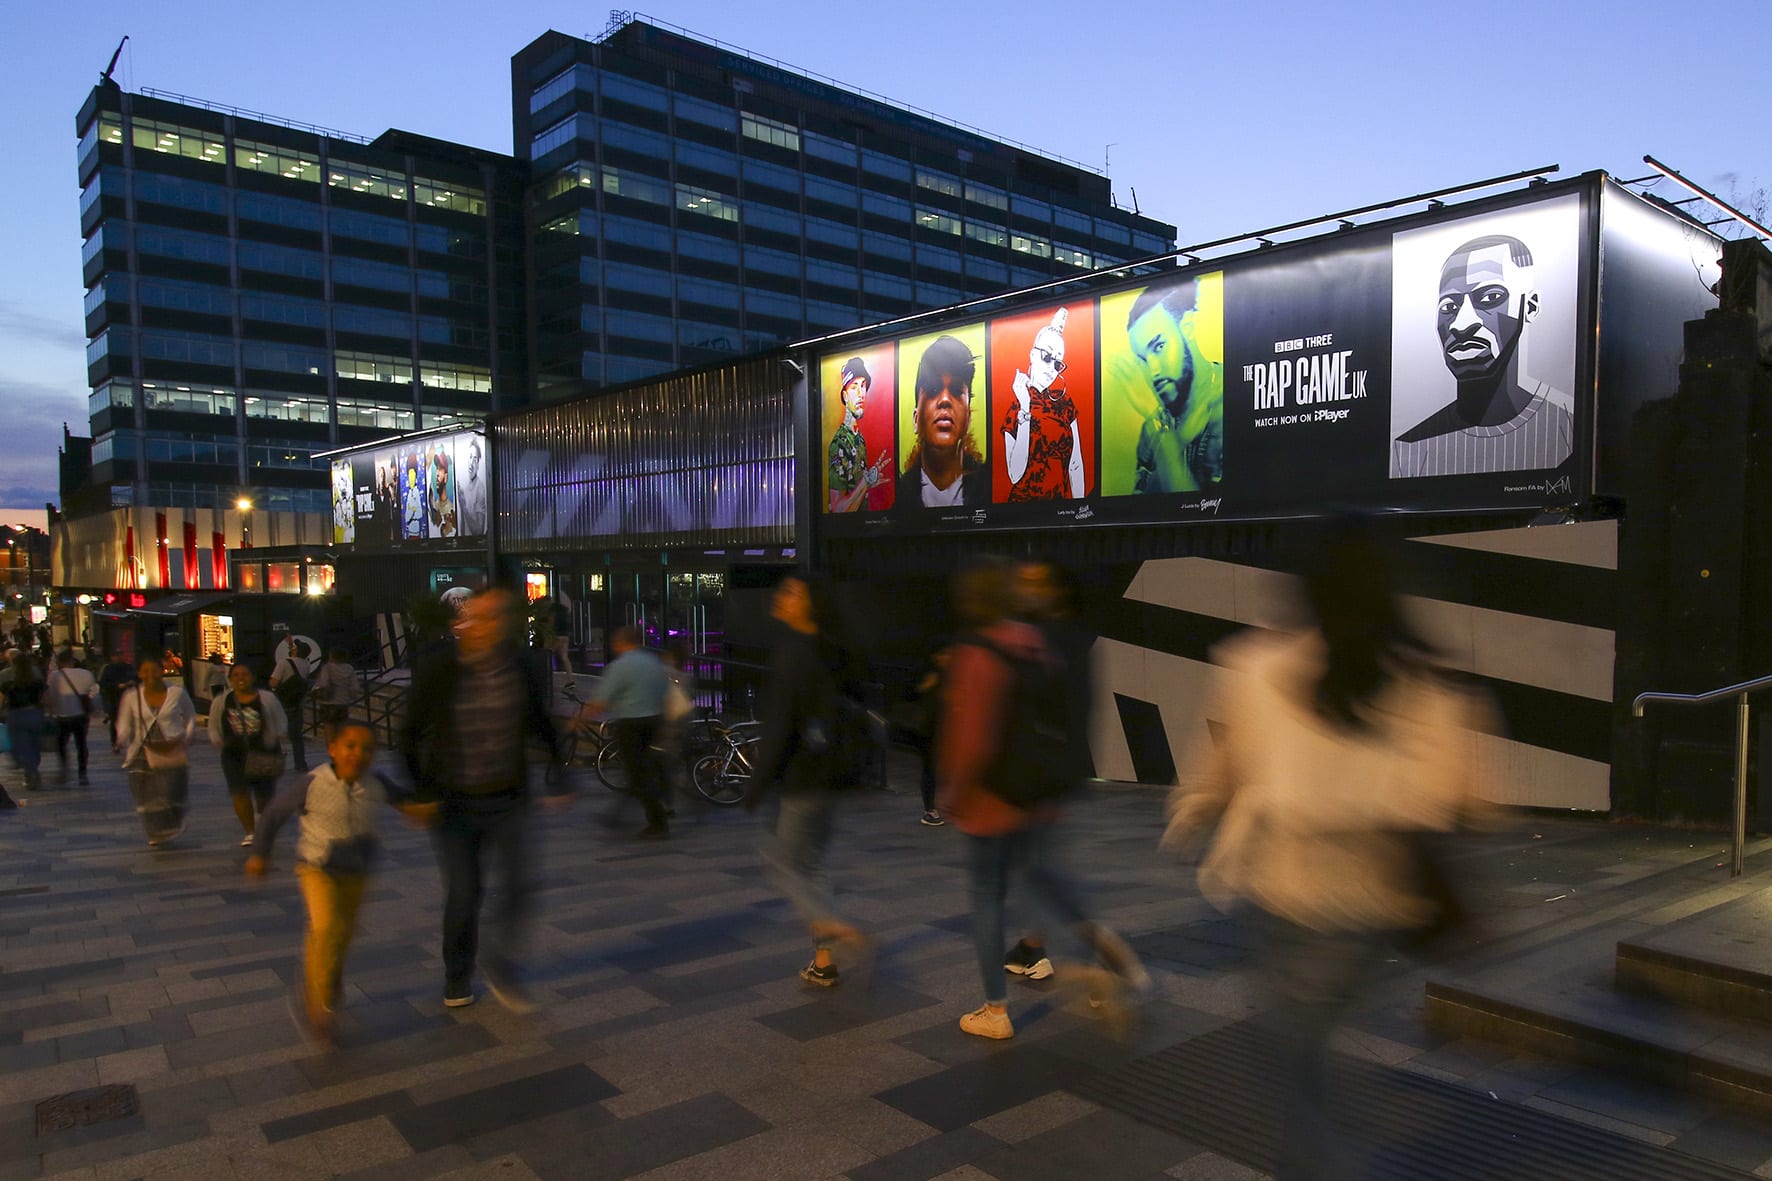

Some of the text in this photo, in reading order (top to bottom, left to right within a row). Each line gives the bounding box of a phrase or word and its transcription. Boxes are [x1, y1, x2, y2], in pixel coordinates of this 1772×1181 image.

[1275, 334, 1333, 353] BBC THREE
[1243, 350, 1368, 411] THE RAP GAME UK
[1254, 408, 1350, 428] WATCH NOW ON iPlayer
